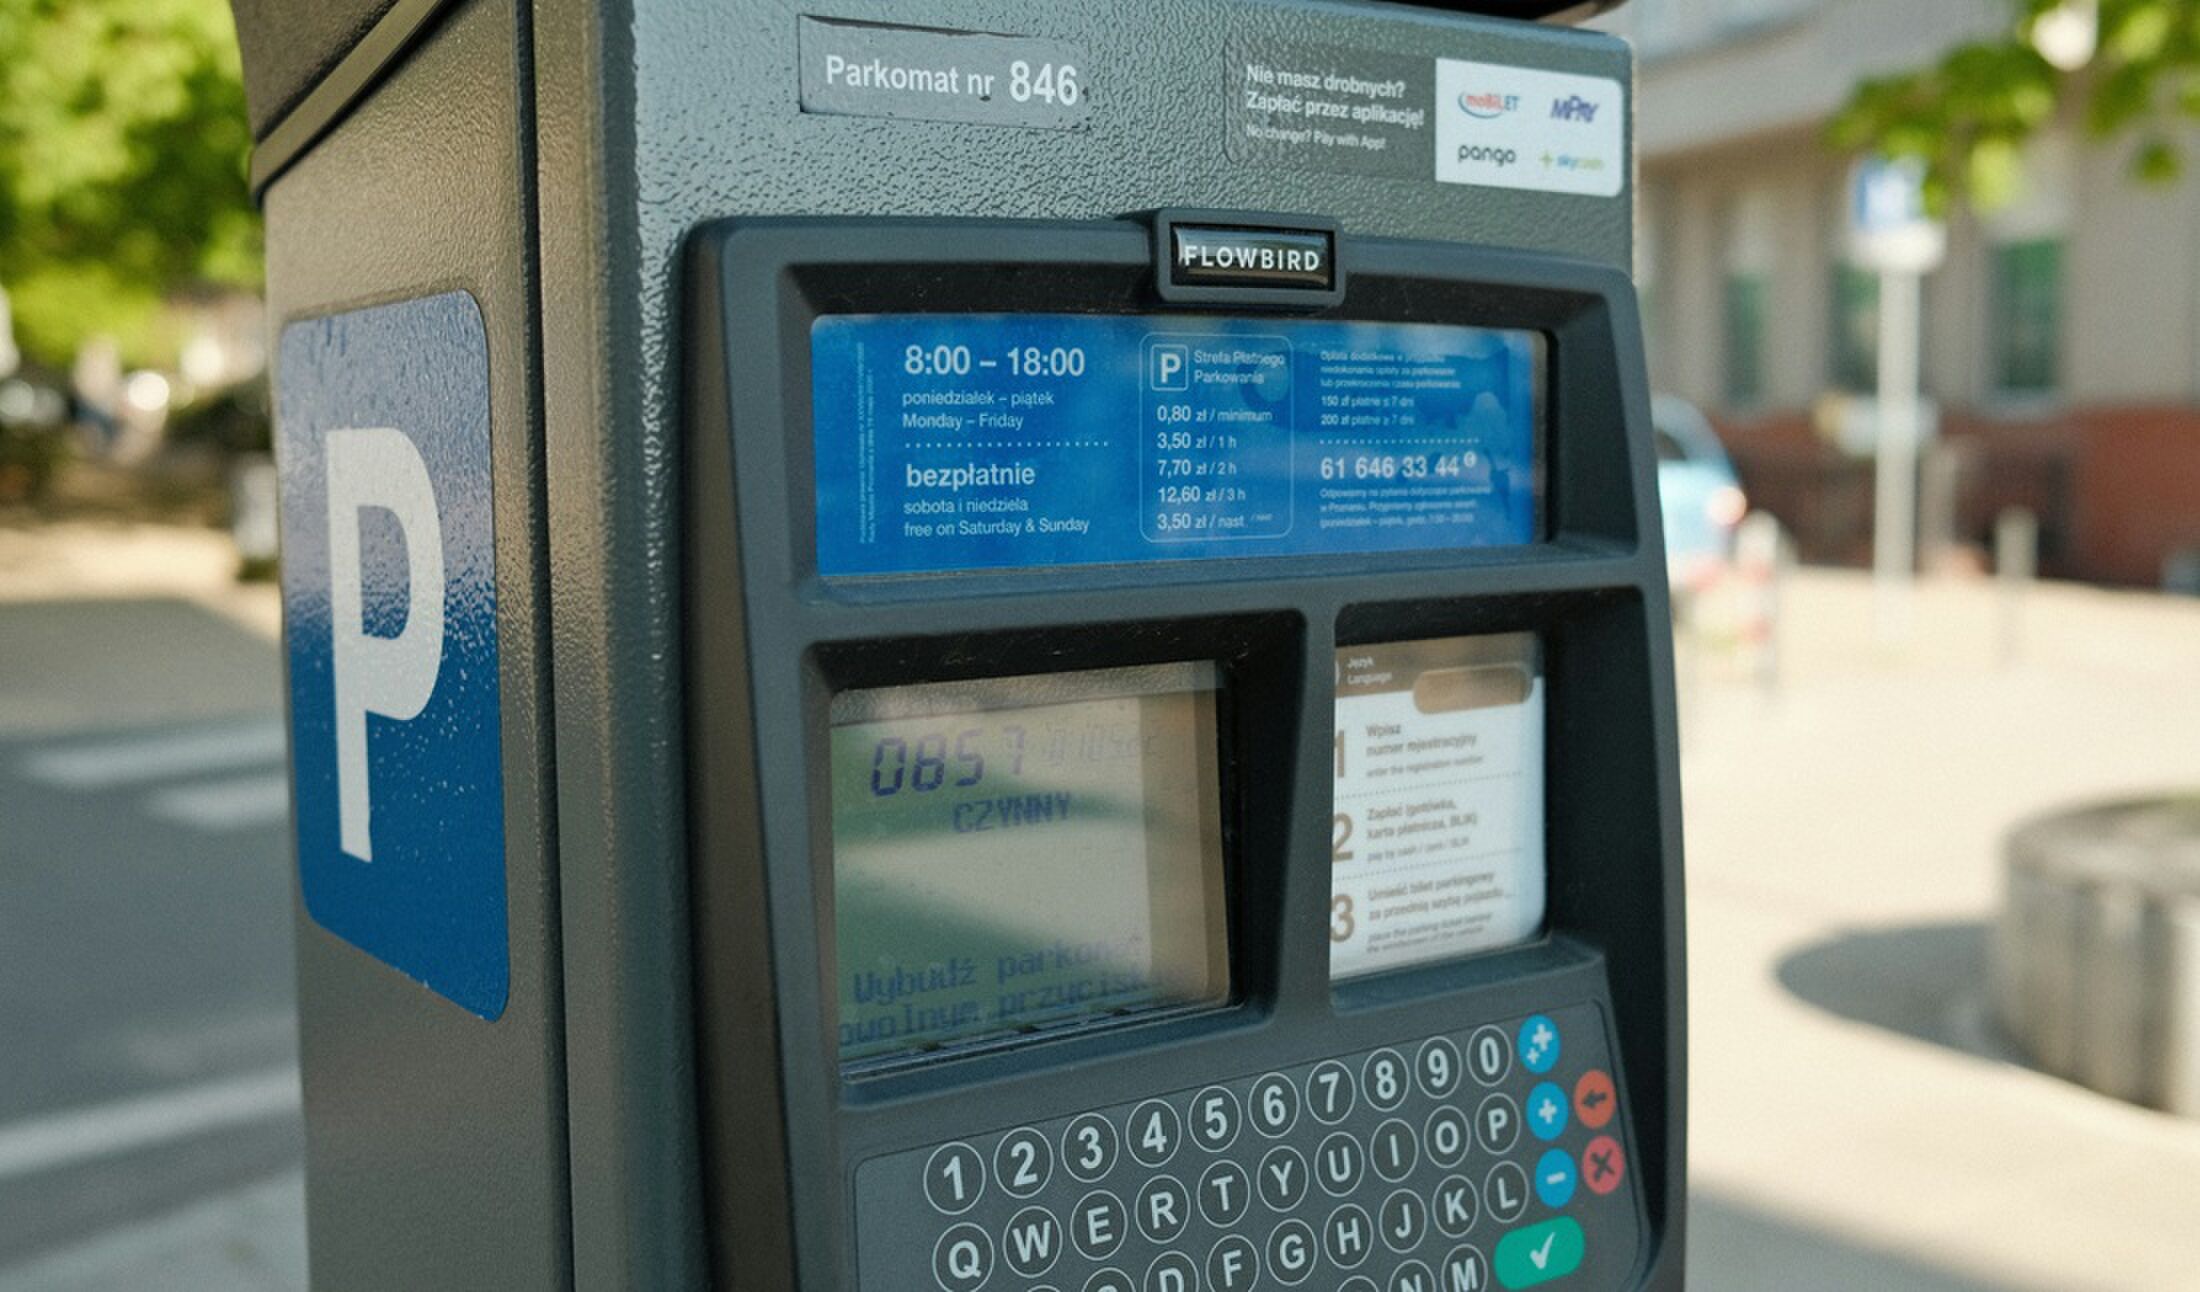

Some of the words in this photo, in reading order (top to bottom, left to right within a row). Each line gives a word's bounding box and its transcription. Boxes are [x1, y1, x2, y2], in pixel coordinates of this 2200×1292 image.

[826, 55, 960, 94] Parkomat
[968, 73, 995, 95] nr
[1009, 60, 1078, 106] 846
[1246, 63, 1274, 84] Nie
[1278, 71, 1321, 90] masz
[1324, 74, 1406, 99] drobnych?
[1246, 91, 1302, 114] Zapłać
[1305, 101, 1349, 118] przez
[1352, 104, 1424, 130] aplikację!
[1458, 145, 1516, 168] pango
[1184, 244, 1320, 272] FLOWBIRD
[904, 344, 971, 376] 8:00
[1007, 347, 1086, 378] 18:00
[1161, 353, 1181, 383] P
[1194, 349, 1233, 364] Strefa
[1234, 350, 1286, 368] Płatnego
[1194, 370, 1265, 385] Parkowania
[902, 390, 995, 408] poniedziałek
[1011, 390, 1055, 408] piątek
[1322, 395, 1338, 407] 150
[902, 413, 963, 431] Monday
[980, 413, 1025, 431] Friday
[1157, 405, 1191, 424] 0,80
[1196, 408, 1207, 422] zł
[1217, 409, 1273, 422] minimum
[1321, 414, 1339, 426] 200
[1157, 432, 1191, 451] 3,50
[1196, 435, 1207, 449] zł
[1228, 435, 1237, 449] h
[906, 462, 1036, 492] bezpłatnie
[1157, 459, 1191, 479] 7,70
[1196, 462, 1207, 475] zł
[1217, 462, 1226, 475] 2
[1228, 461, 1237, 475] h
[1321, 456, 1345, 480] 61
[1355, 456, 1395, 479] 646
[1402, 455, 1428, 478] 33
[1435, 455, 1459, 477] 44
[904, 498, 955, 514] sobota
[959, 499, 963, 512] i
[967, 497, 1029, 513] niedziela
[1158, 486, 1201, 505] 12,60
[1205, 488, 1216, 502] zł
[1227, 488, 1235, 501] 3
[1238, 487, 1246, 501] h
[904, 522, 932, 537] free
[936, 524, 955, 535] on
[959, 518, 1021, 537] Saturday
[1026, 520, 1036, 533] &
[1040, 517, 1090, 534] Sunday
[1157, 513, 1191, 532] 3,50
[1195, 514, 1207, 529] zł
[326, 427, 444, 863] P
[870, 727, 1025, 798] 0857
[953, 791, 1073, 833] CZYNNY
[1331, 813, 1353, 861] 2
[1331, 893, 1355, 943] 3
[853, 956, 978, 1006] Wybudź
[943, 1155, 964, 1201] 1
[1011, 1141, 1039, 1188] 2
[1081, 1126, 1102, 1170] 3
[1143, 1111, 1166, 1154] 4
[1204, 1099, 1228, 1140] 5
[1263, 1085, 1287, 1126] 6
[1319, 1072, 1340, 1113] 7
[1375, 1060, 1397, 1101] 8
[1427, 1047, 1450, 1088] 9
[1480, 1037, 1501, 1077] 0
[948, 1240, 981, 1280] Q
[1012, 1220, 1052, 1263] W
[1087, 1205, 1113, 1246] E
[1149, 1191, 1178, 1229] R
[1212, 1176, 1234, 1212] T
[1269, 1160, 1296, 1196] Y
[1328, 1146, 1352, 1181] U
[1389, 1133, 1399, 1167] I
[1434, 1119, 1459, 1154] O
[1487, 1107, 1510, 1142] P
[1221, 1249, 1245, 1286] F
[1279, 1234, 1306, 1271] G
[1336, 1218, 1362, 1255] H
[1395, 1203, 1414, 1239] J
[1444, 1187, 1471, 1223] K
[1497, 1173, 1519, 1210] L
[1451, 1257, 1479, 1292] M
